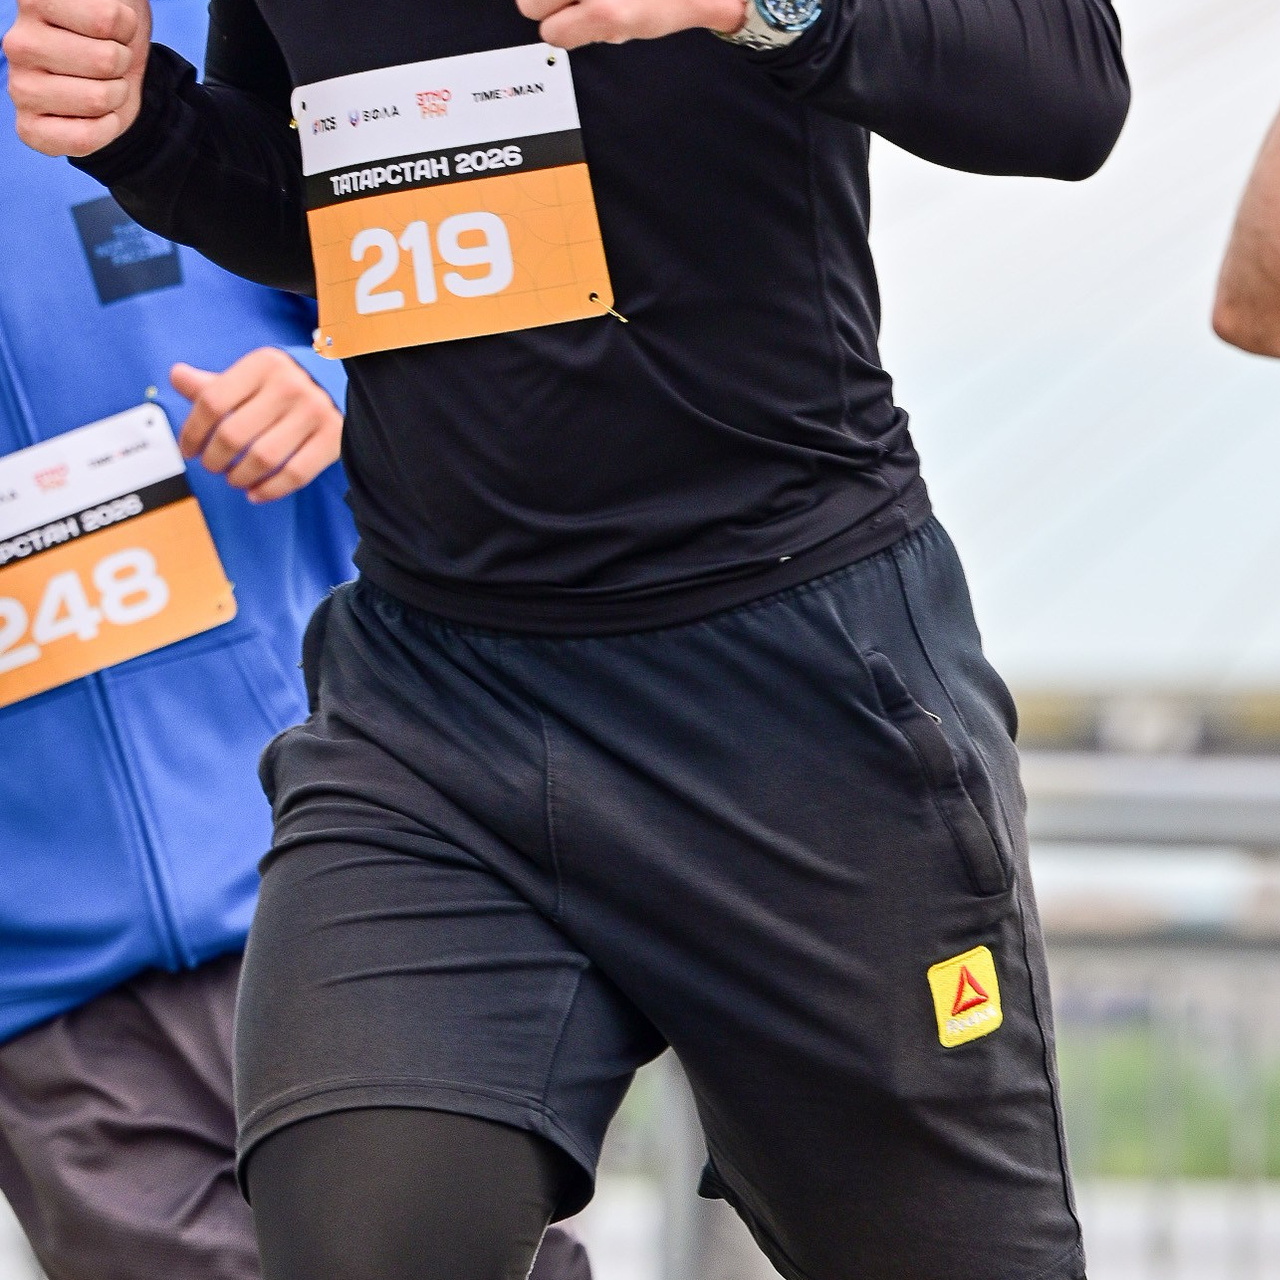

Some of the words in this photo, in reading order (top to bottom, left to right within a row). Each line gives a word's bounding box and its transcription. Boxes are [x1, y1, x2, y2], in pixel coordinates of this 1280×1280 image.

[329, 156, 450, 196] ТАТАРСТАН
[454, 145, 523, 174] 2026
[350, 211, 514, 315] 219
[0, 547, 169, 672] 248
